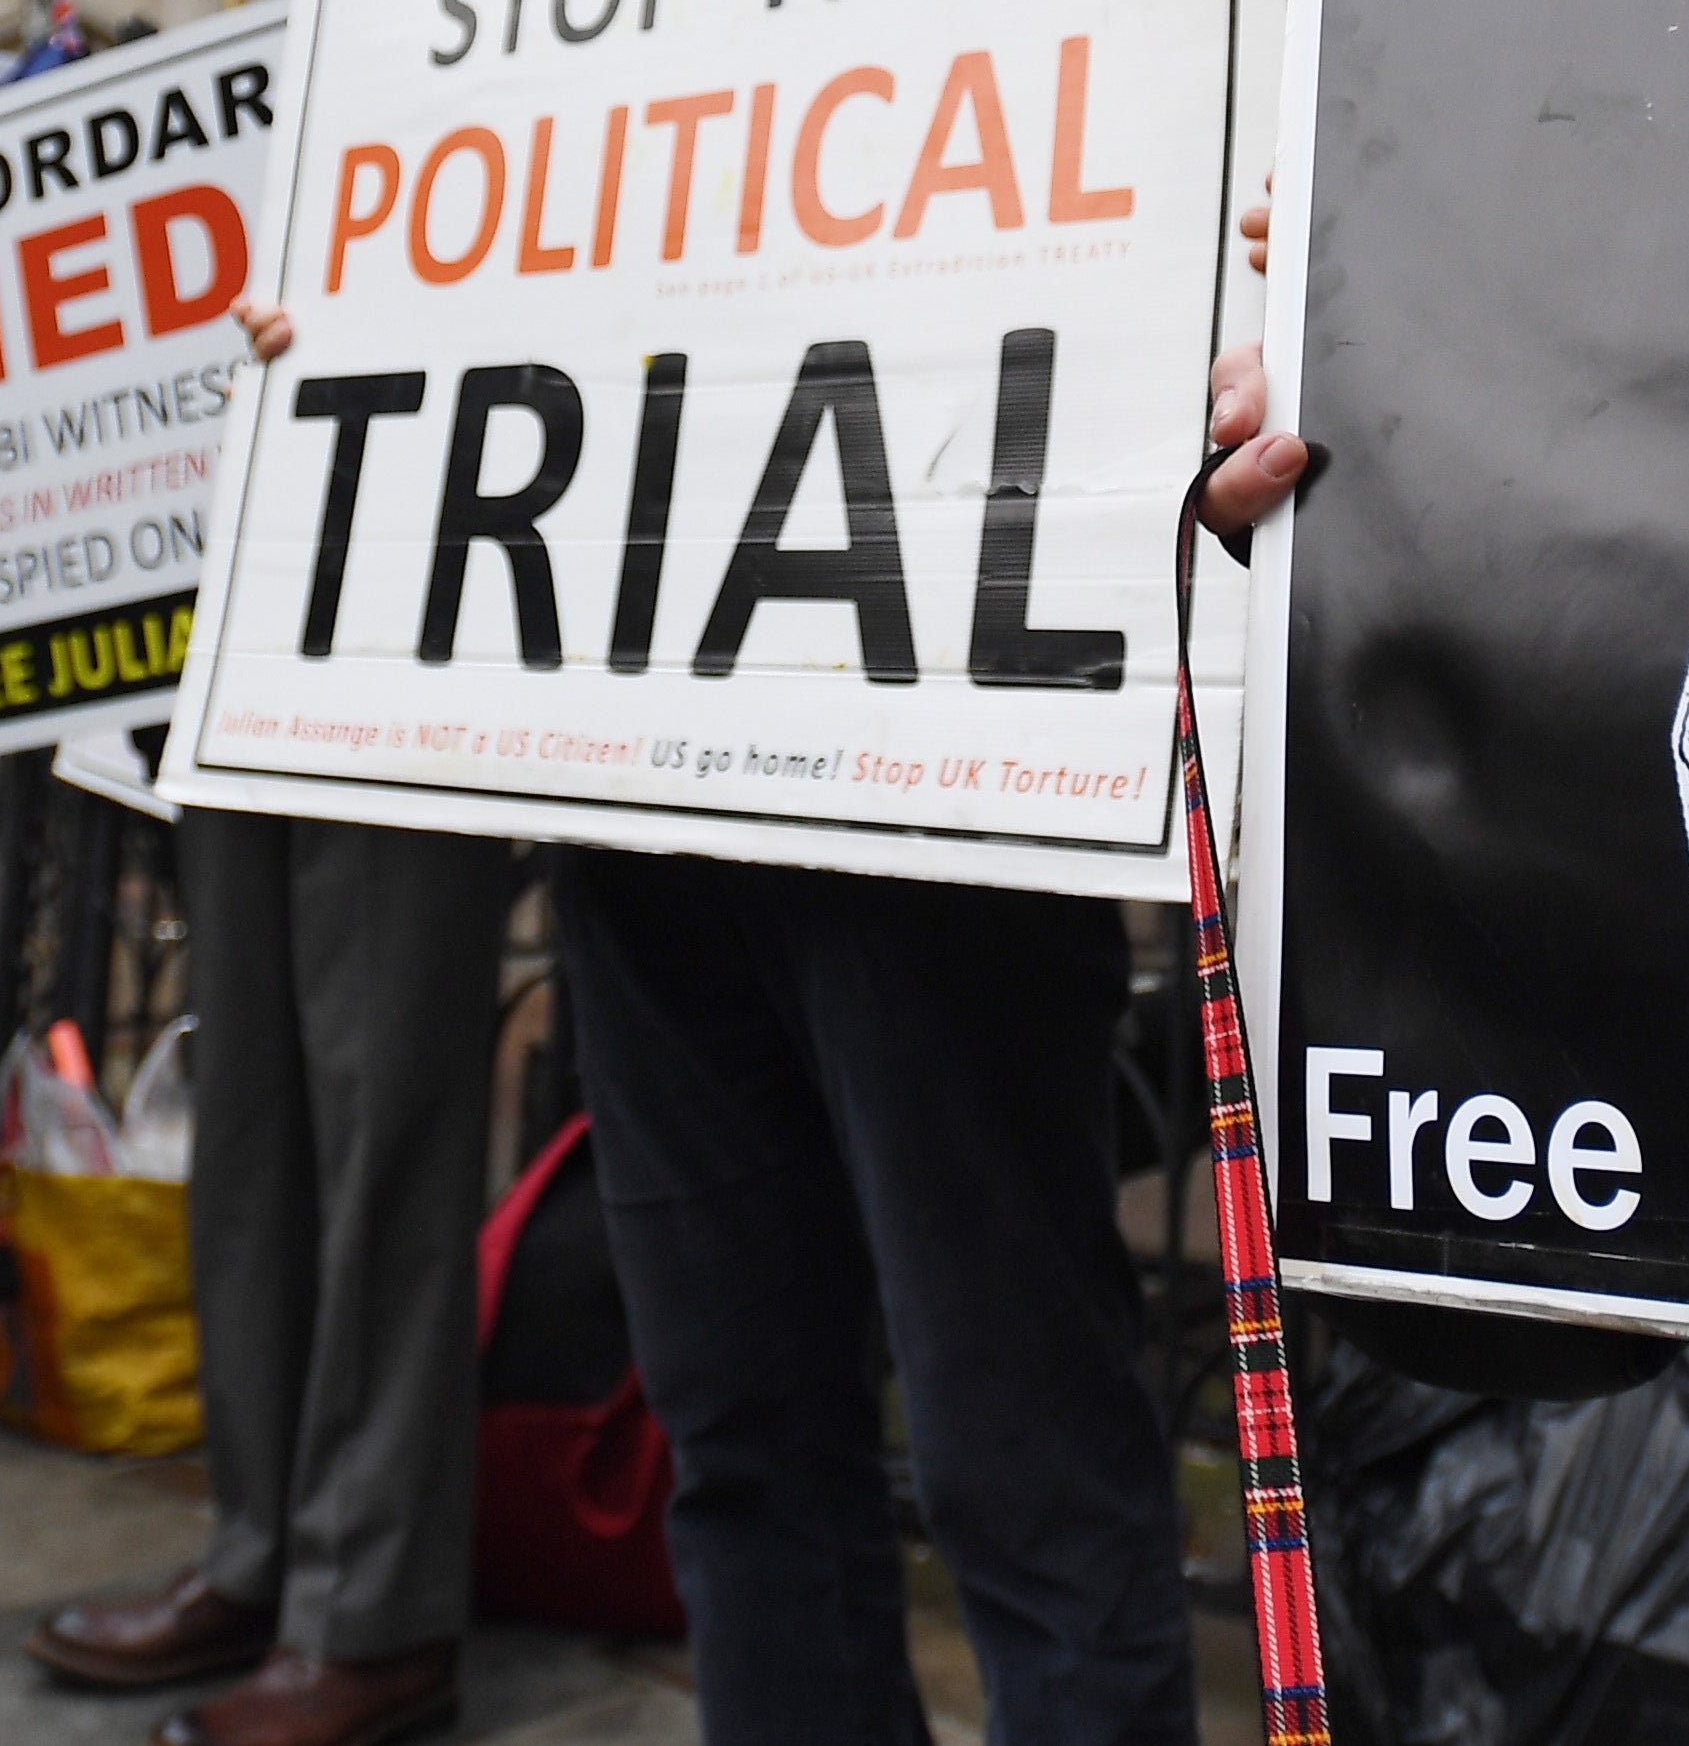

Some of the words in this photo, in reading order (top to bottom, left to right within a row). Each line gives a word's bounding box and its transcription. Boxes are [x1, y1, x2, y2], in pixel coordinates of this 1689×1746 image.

[322, 35, 1135, 296] POLITICAL
[1039, 240, 1132, 266] TREATY
[44, 360, 244, 455] WITNES
[23, 489, 53, 524] IN
[63, 448, 208, 512] WRITTEN
[292, 328, 1126, 692] TRIAL
[130, 509, 203, 571] ON
[219, 709, 280, 738] Julian
[288, 713, 379, 752] Assange
[388, 718, 407, 748] is
[418, 721, 467, 753] NOT
[496, 730, 530, 757] US
[538, 731, 645, 766] Citizen!
[650, 738, 687, 771] US
[695, 746, 731, 780] go
[742, 743, 844, 782] home!
[851, 751, 924, 793] Stop
[936, 757, 987, 791] UK
[999, 761, 1147, 801] Torture!
[1307, 1046, 1643, 1233] Free
